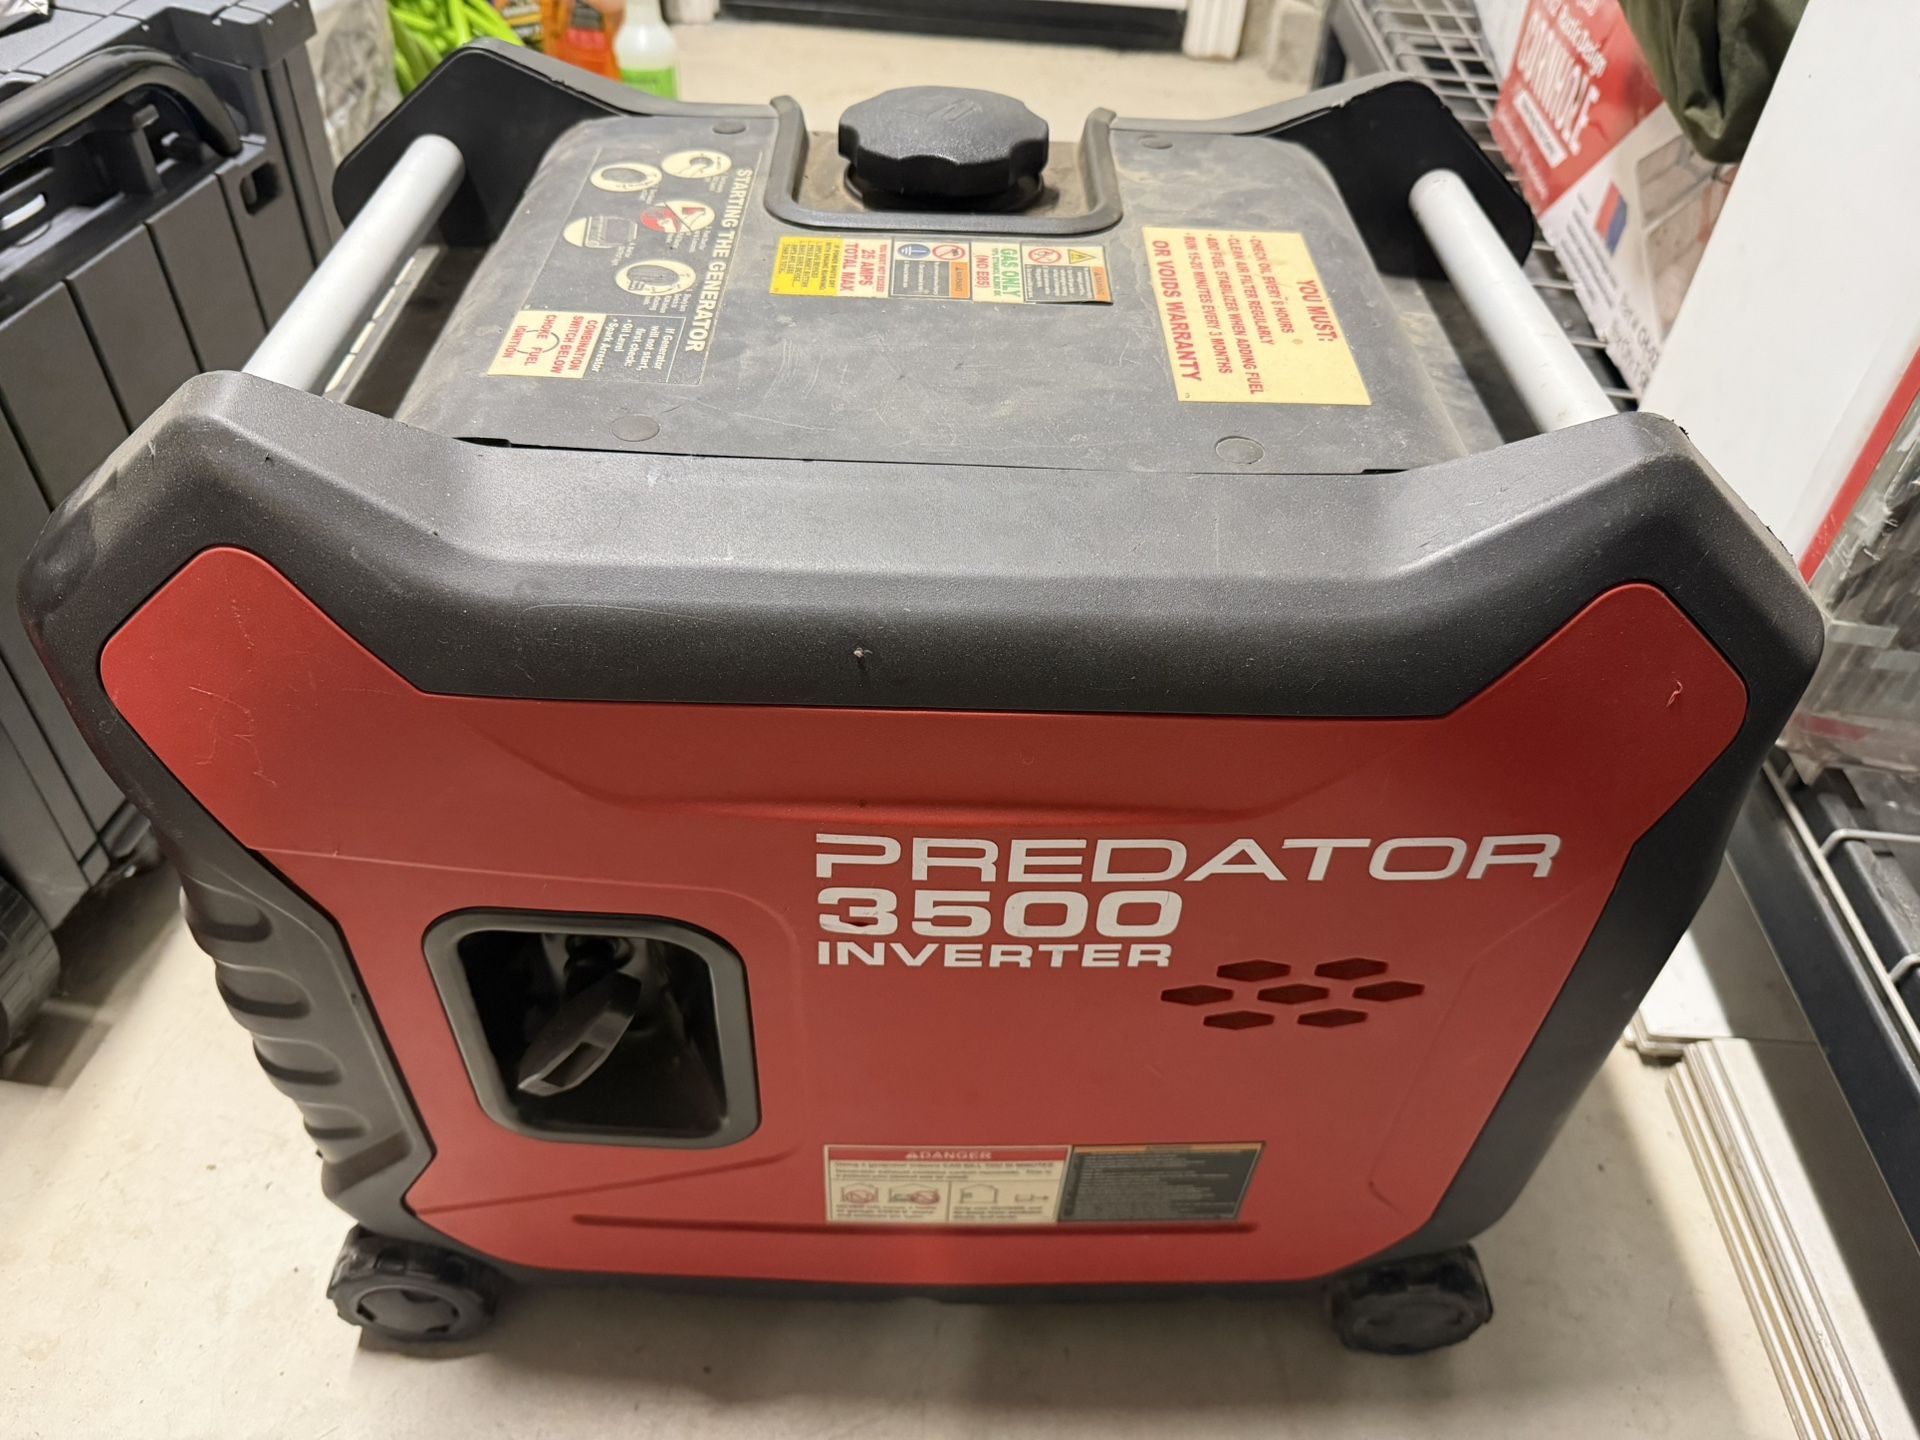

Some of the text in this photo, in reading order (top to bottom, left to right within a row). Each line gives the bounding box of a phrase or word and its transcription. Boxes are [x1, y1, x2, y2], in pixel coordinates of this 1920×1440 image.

[720, 169, 753, 228] STARTING
[712, 231, 736, 258] THE
[1183, 236, 1198, 250] RUN
[1250, 239, 1268, 262] CHECK
[840, 243, 859, 292] TOTAL MAX
[859, 249, 876, 286] 25 AMPS
[974, 254, 991, 288] (NO E85)
[1000, 248, 1021, 298] GAS ONLY
[1188, 252, 1204, 270] 15-20
[1258, 263, 1272, 275] OIL
[1192, 271, 1213, 304] MINUTES
[1227, 238, 1275, 345] CLEAN AIR FILTER REGULARLY
[1262, 276, 1282, 300] EVERY
[685, 262, 726, 352] GENERATOR
[1152, 240, 1202, 382] OR VOIDS WARRANTY
[1201, 305, 1221, 330] EVERY
[1206, 237, 1264, 395] ADD FUEL STABILIZER WHEN ADDING FUEL
[1273, 307, 1295, 334] HOURS
[1296, 280, 1338, 342] YOU MUST:
[502, 325, 528, 358] IGNITION
[537, 314, 557, 339] CHOKE
[614, 323, 633, 352] Oil Level
[632, 328, 647, 342] first
[649, 325, 660, 338] will
[524, 347, 542, 366] FUEL
[550, 315, 584, 374] SWITCH BELOW
[568, 320, 598, 370] COMBINATION
[592, 322, 619, 373] Spark Arrestor
[644, 339, 656, 350] not
[654, 335, 673, 370] Generator
[1210, 338, 1233, 374] MONTHS
[815, 833, 1562, 882] PREDATOR
[817, 887, 1183, 938] 3500
[817, 941, 1174, 969] INVERTER
[920, 1150, 992, 1160] DANGER
